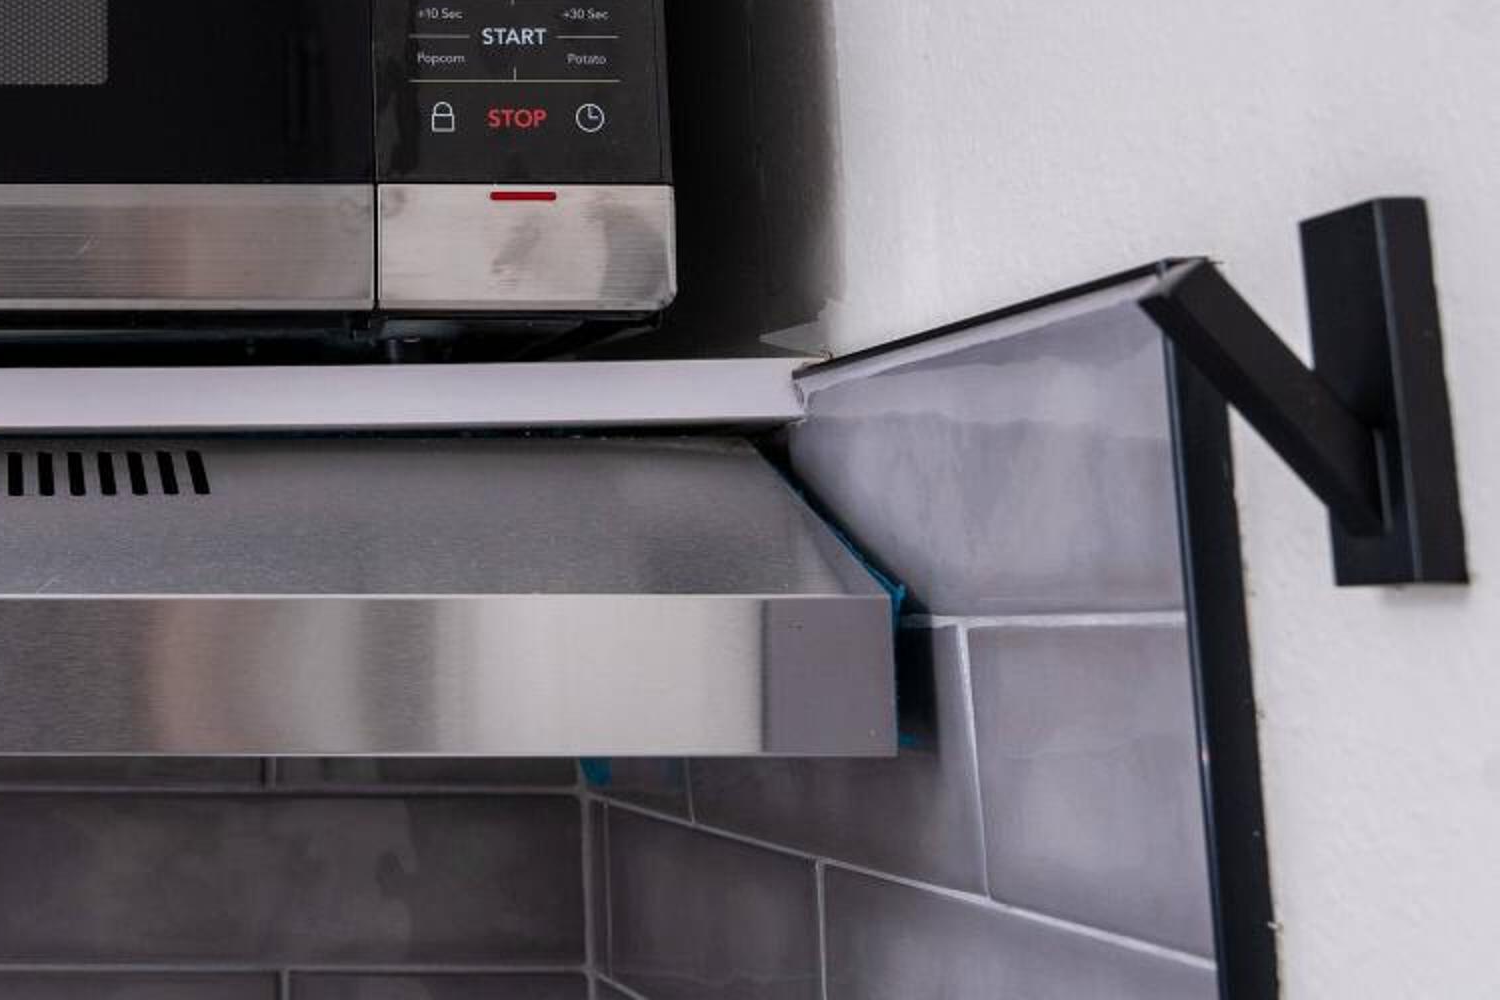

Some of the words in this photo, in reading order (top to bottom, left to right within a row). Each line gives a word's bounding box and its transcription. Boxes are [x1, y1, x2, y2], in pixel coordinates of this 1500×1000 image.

[441, 8, 463, 20] Sec
[587, 8, 609, 20] Sec
[481, 28, 547, 45] START
[417, 52, 466, 67] Popcorn
[567, 53, 607, 65] Potato
[487, 109, 547, 129] STOP
